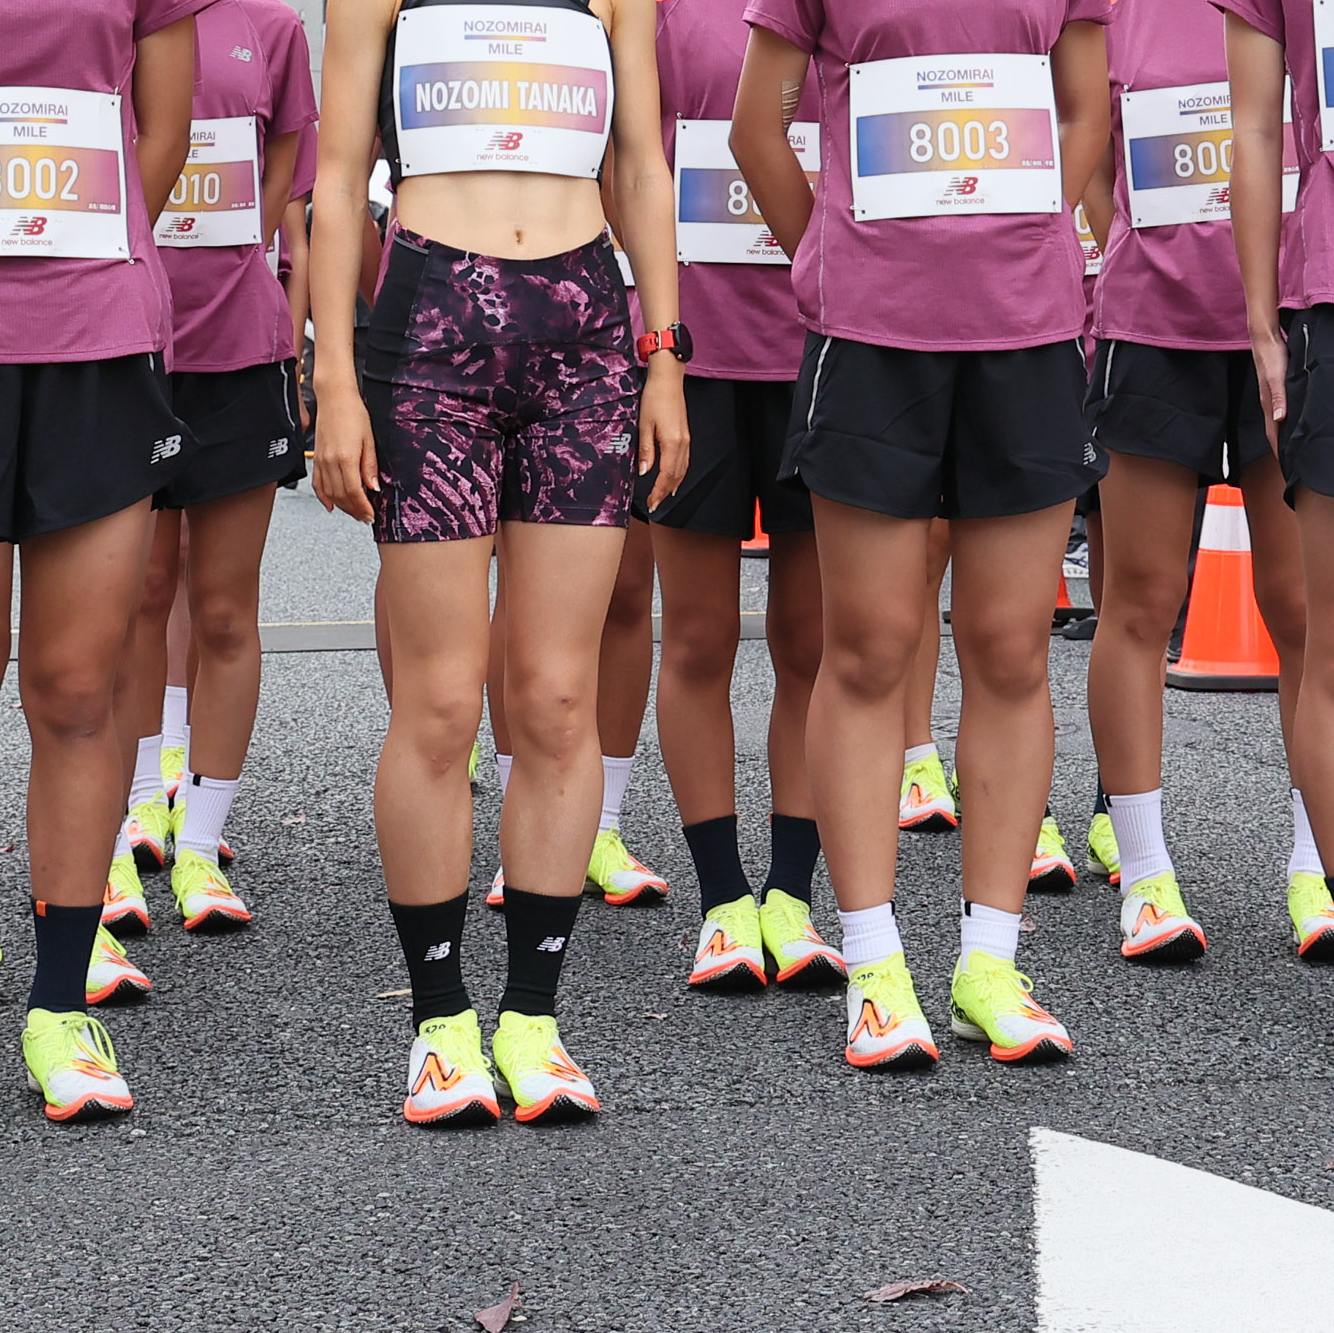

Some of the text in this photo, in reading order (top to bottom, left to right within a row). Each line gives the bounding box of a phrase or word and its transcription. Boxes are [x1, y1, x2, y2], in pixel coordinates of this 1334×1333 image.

[463, 20, 547, 35] NOZOMIRAI
[487, 43, 524, 55] MILE
[916, 69, 994, 82] NOZOMIRAI
[415, 80, 598, 117] NOZOMI TANAKA
[941, 90, 974, 103] MILE
[1199, 114, 1228, 126] MILE
[13, 126, 47, 138] MILE
[909, 120, 1010, 163] 8003
[495, 153, 530, 162] balance
[954, 197, 985, 205] balance
[1199, 206, 1213, 214] new
[20, 238, 53, 246] balance
[173, 232, 200, 240] balance
[746, 248, 761, 256] new
